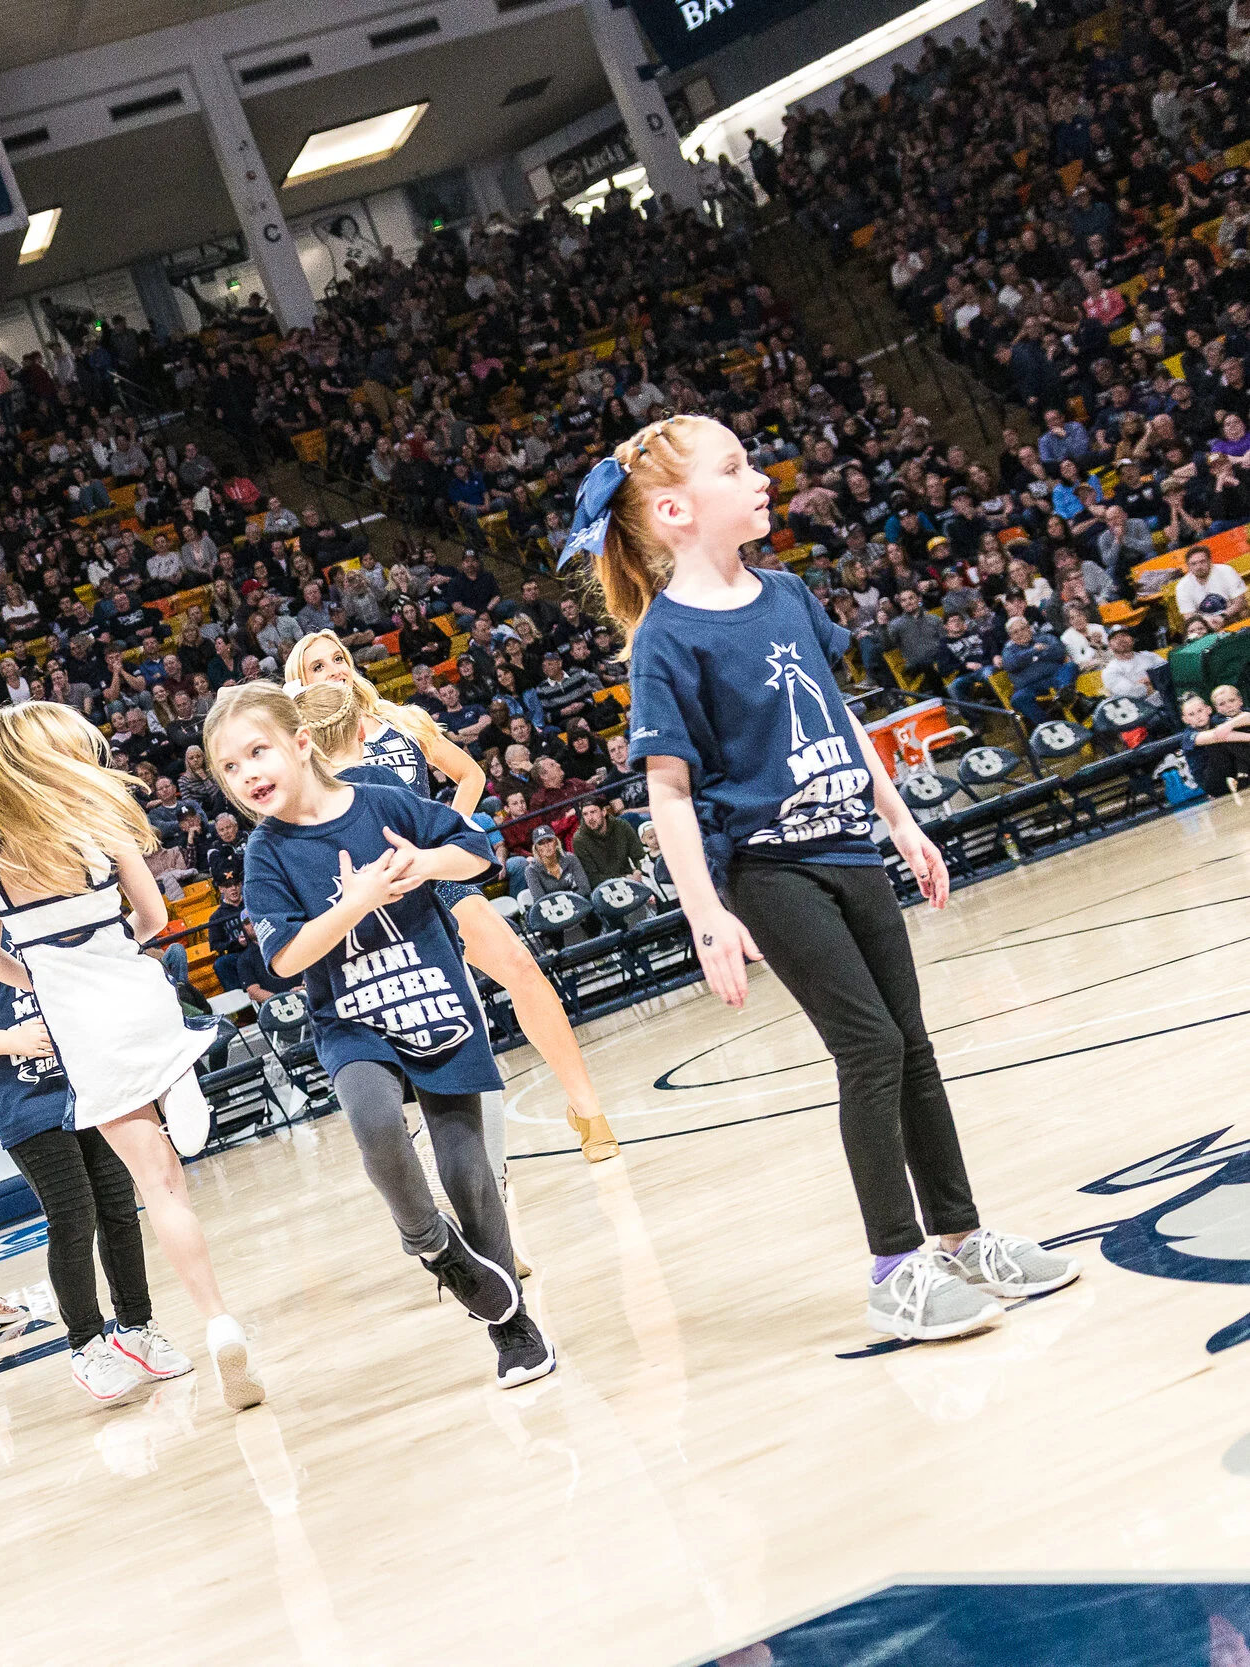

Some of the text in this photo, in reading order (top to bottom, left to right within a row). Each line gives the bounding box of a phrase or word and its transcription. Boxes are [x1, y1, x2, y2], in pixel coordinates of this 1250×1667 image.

[680, 0, 735, 31] BA
[264, 223, 282, 243] C
[341, 941, 423, 989] MINI
[334, 966, 452, 1019] CHEER
[352, 993, 467, 1032] LINIC
